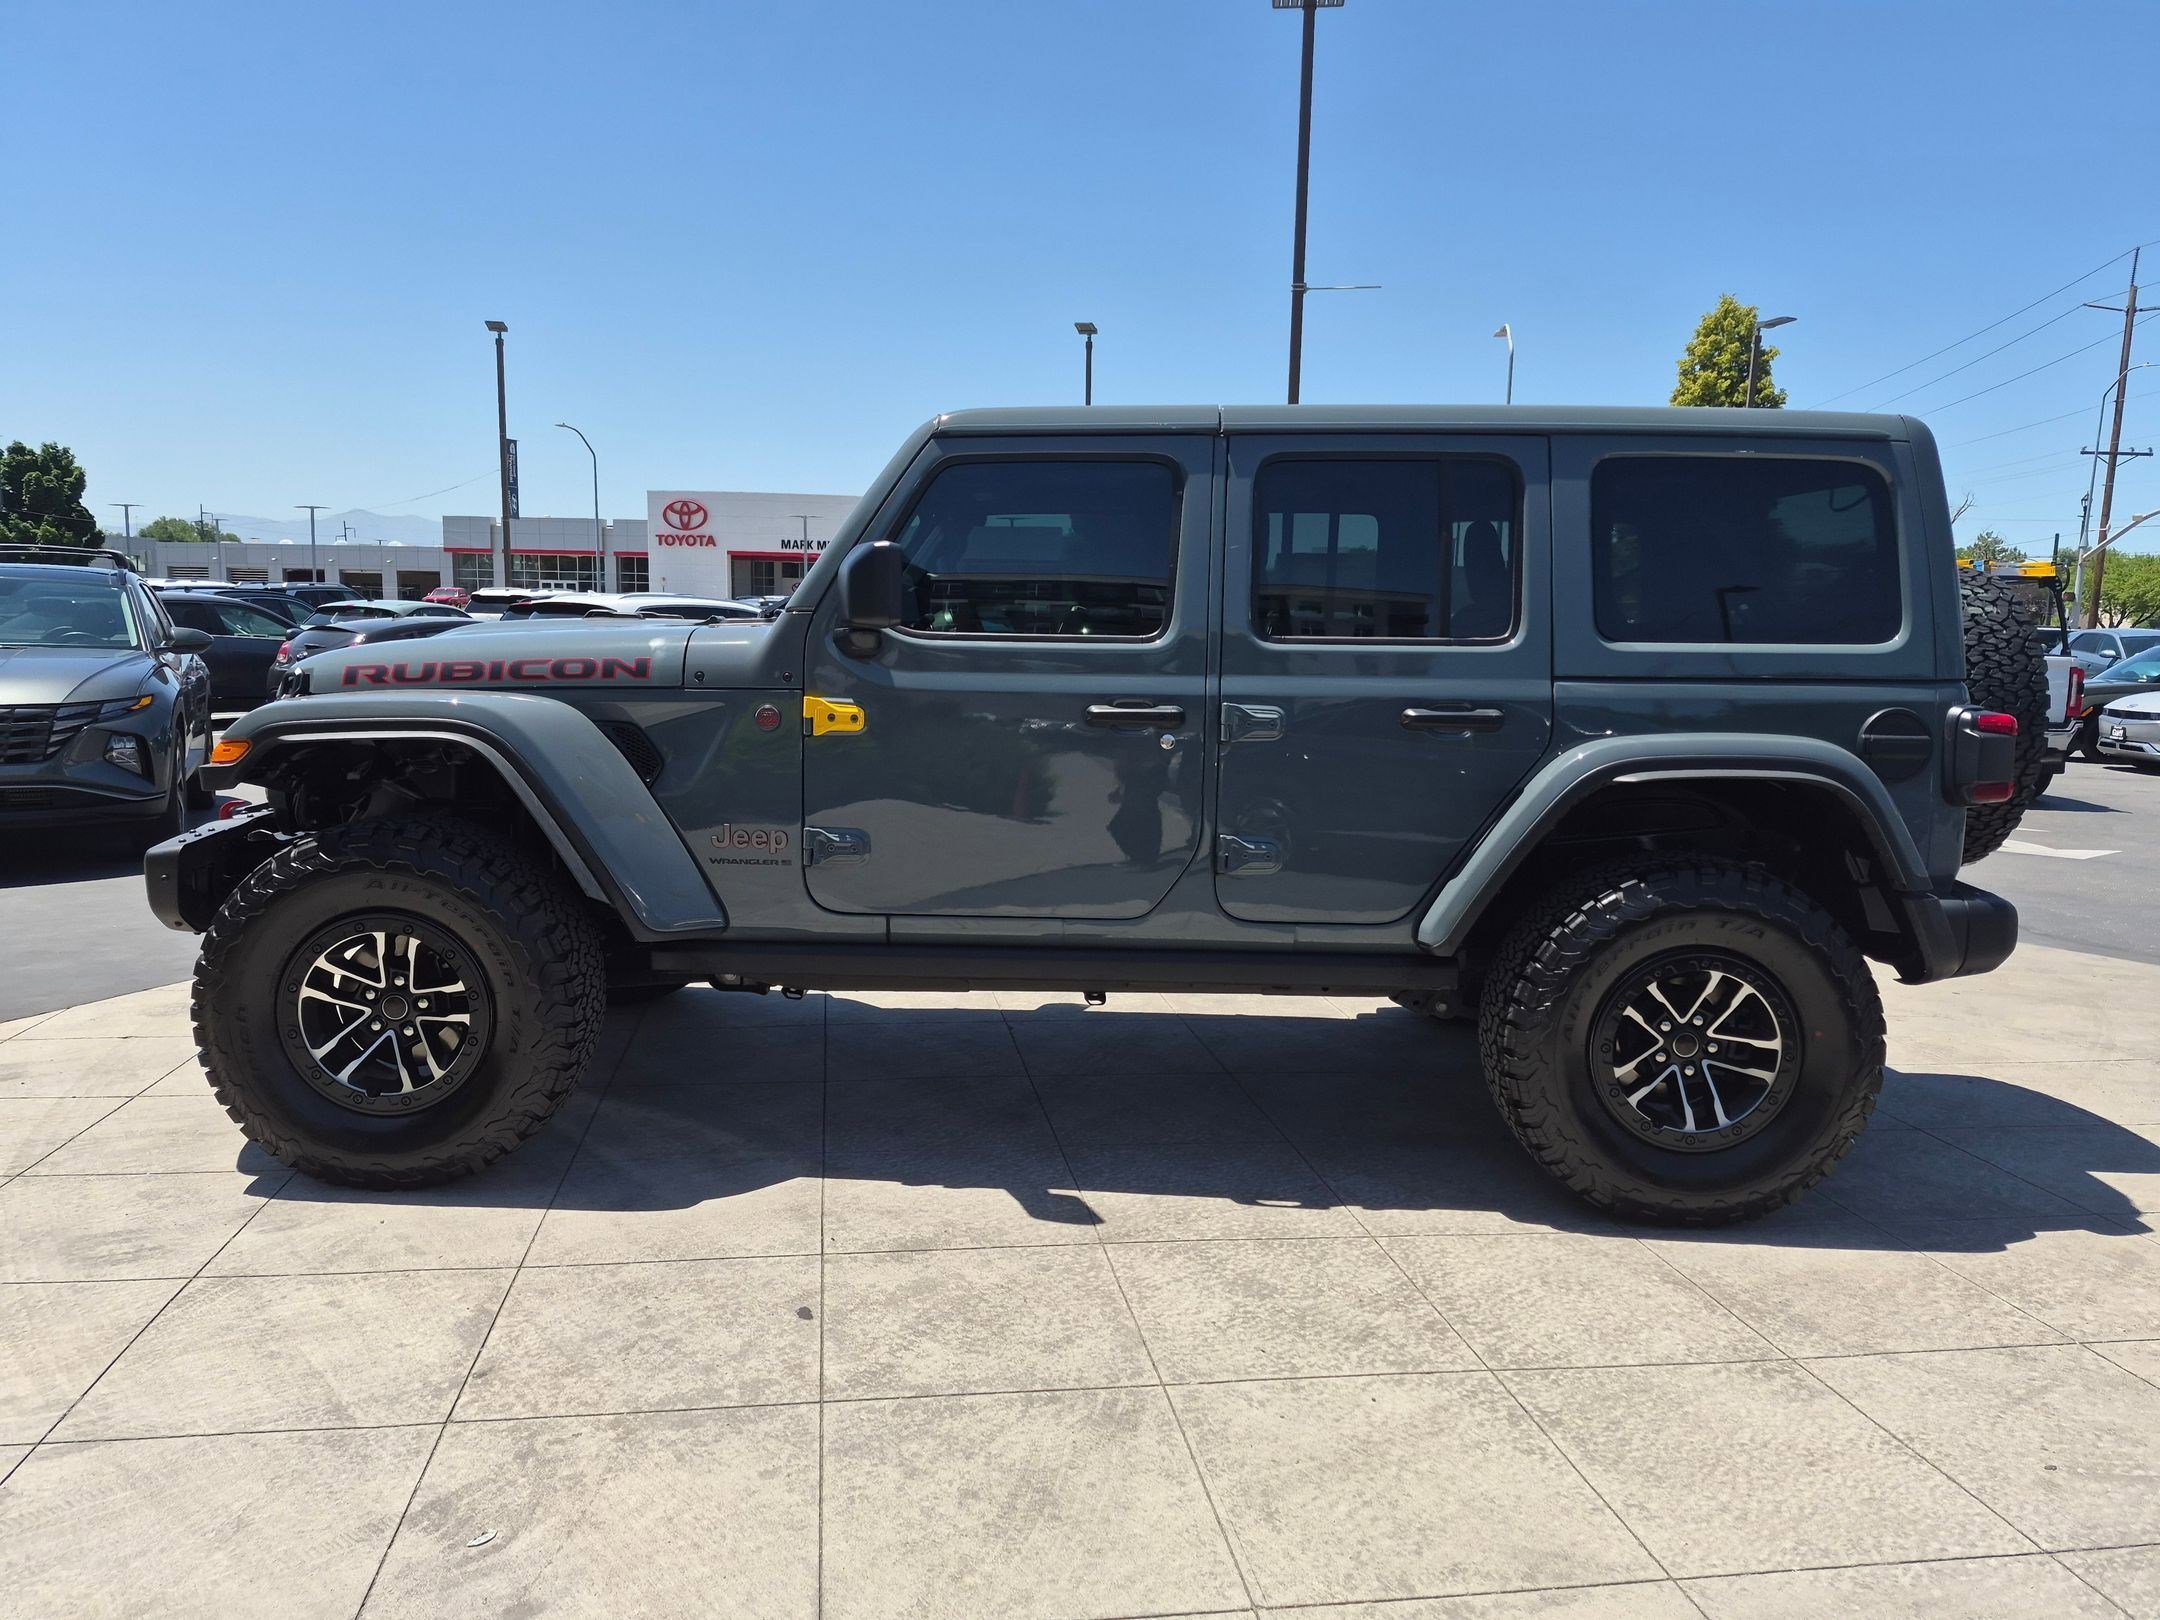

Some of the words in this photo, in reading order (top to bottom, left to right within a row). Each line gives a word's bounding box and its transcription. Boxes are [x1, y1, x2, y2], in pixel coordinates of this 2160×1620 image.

[655, 534, 717, 547] TOYOTA
[817, 540, 830, 550] M
[341, 657, 652, 687] RUBICON
[711, 823, 789, 854] Jeep
[709, 857, 779, 866] WRANGLER
